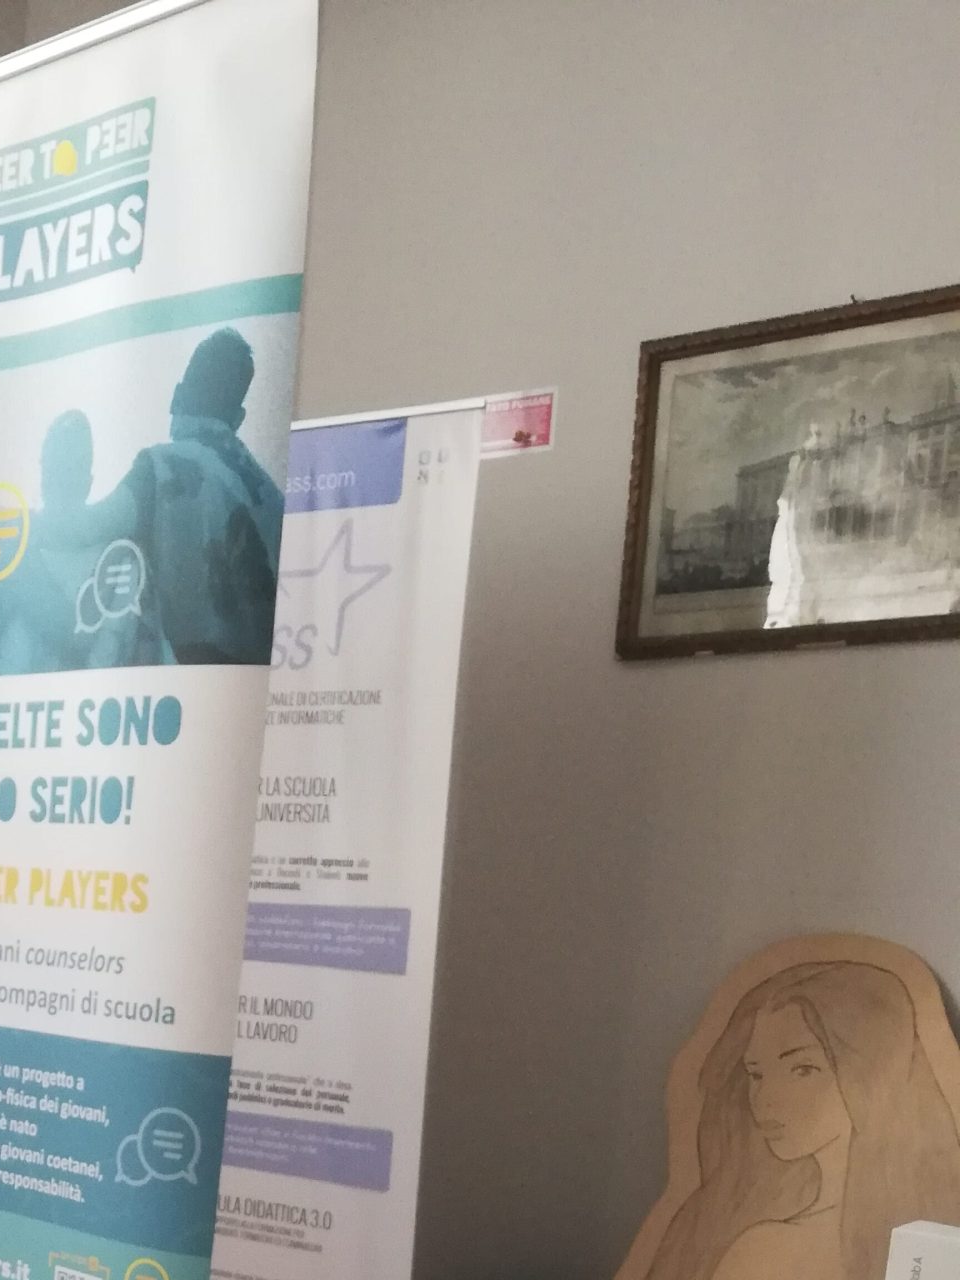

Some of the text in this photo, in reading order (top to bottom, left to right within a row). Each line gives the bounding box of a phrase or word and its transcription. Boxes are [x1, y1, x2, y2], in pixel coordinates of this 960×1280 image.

[76, 695, 182, 747] SONO
[29, 775, 135, 825] SERIO!
[266, 777, 337, 797] LA SCUOLA
[29, 868, 149, 914] PLAYERS
[25, 944, 126, 975] counselors
[81, 989, 98, 1016] di
[104, 996, 176, 1026] scuola
[250, 996, 260, 1016] IL
[263, 998, 314, 1021] MONDO
[246, 1021, 298, 1044] LAVORO
[3, 1064, 19, 1079] un
[22, 1067, 74, 1089] progetto
[76, 1077, 85, 1091] a
[0, 1113, 7, 1130] è
[10, 1119, 38, 1136] nato
[39, 1094, 59, 1114] dei
[60, 1100, 110, 1128] giovani,
[0, 1142, 45, 1165] giovani
[47, 1153, 103, 1182] coetanei,
[244, 1197, 308, 1227] DIDATTICA
[311, 1209, 332, 1230] 3.0
